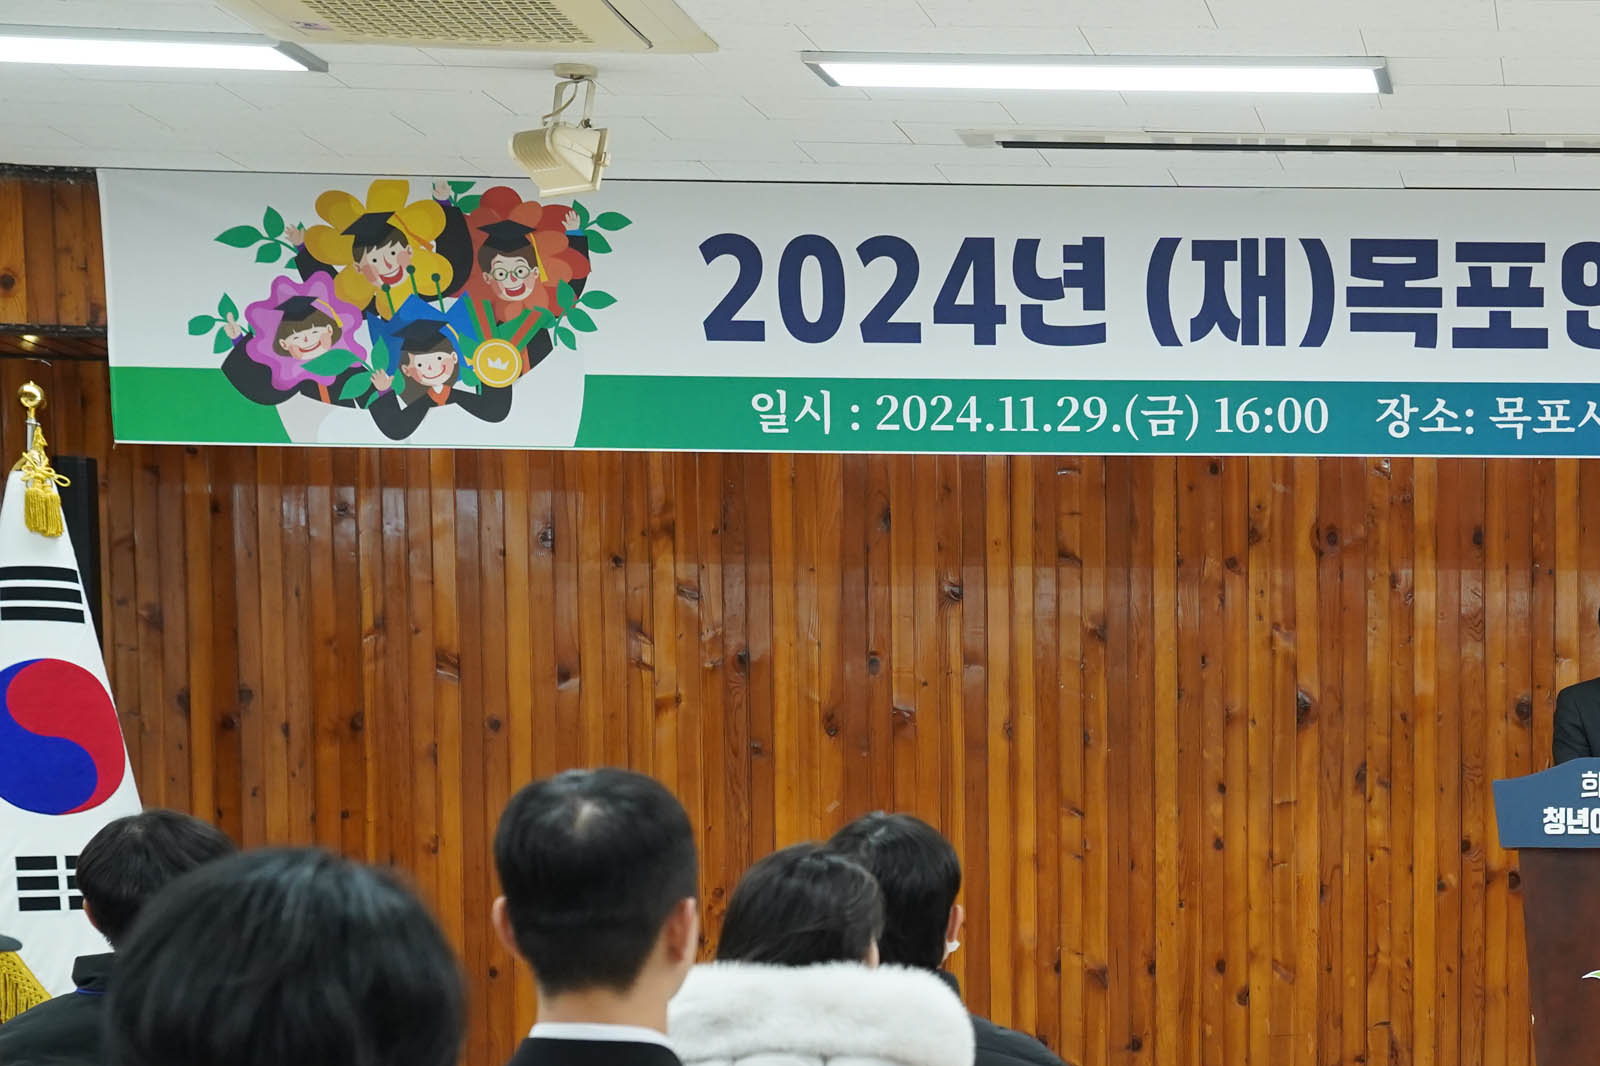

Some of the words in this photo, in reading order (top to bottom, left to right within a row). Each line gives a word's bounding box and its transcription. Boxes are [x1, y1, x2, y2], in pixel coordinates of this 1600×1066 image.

[699, 232, 1106, 347] 2024년
[876, 394, 1199, 441] 2024.11.29.(금)
[1216, 397, 1329, 434] 16:00
[1376, 393, 1474, 439] 장소:
